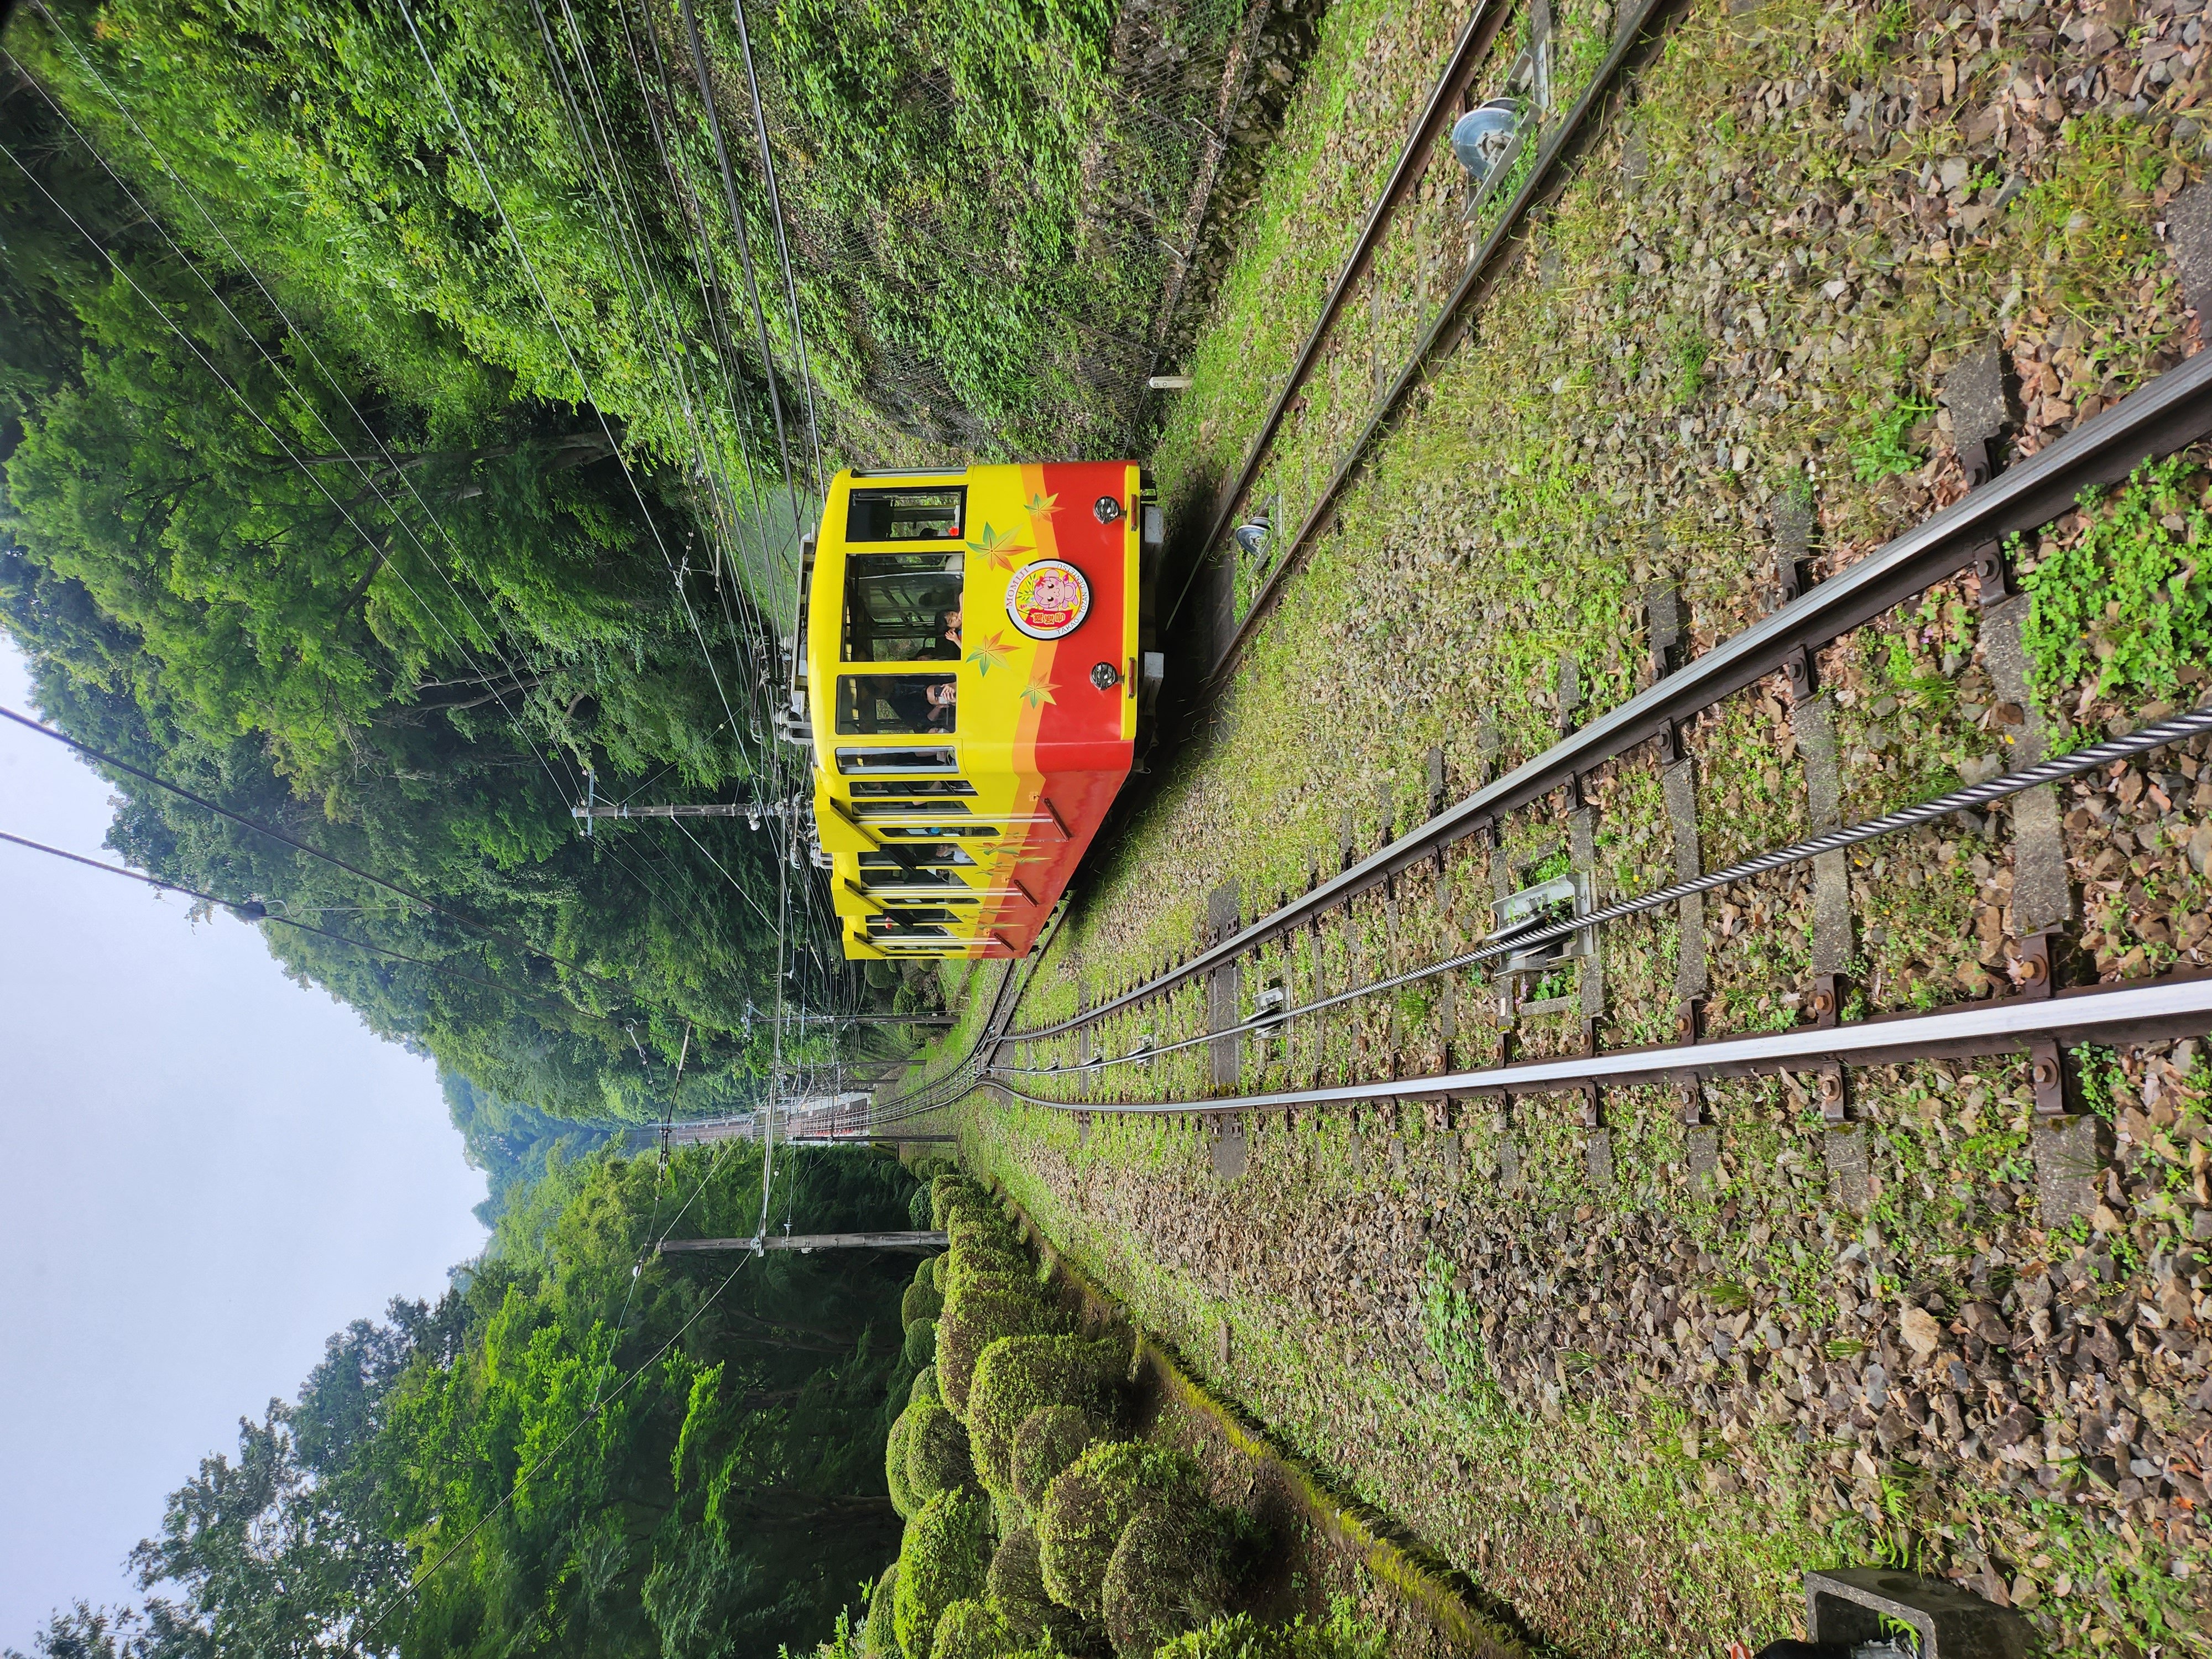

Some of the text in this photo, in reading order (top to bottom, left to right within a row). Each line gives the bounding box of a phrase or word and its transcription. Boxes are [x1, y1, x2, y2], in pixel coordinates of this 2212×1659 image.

[1005, 567, 1029, 607] MOMIJI
[1057, 563, 1088, 635] TAKAO TOZAN DENTETSU
[1032, 612, 1066, 624] 織姫号
